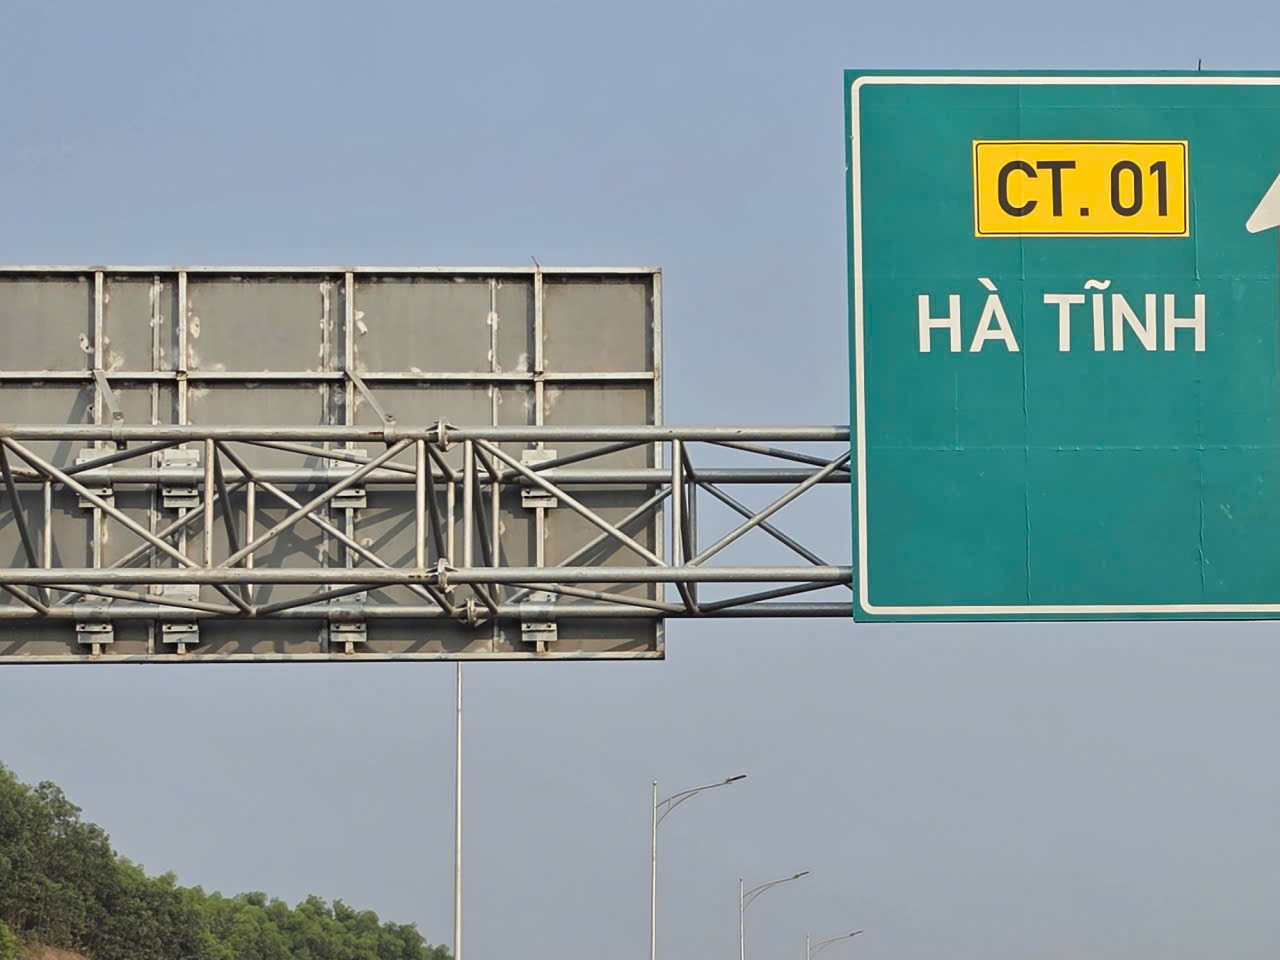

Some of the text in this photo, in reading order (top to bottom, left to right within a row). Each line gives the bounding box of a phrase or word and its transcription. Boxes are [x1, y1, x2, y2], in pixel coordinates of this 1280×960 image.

[997, 160, 1169, 217] CT. 01
[917, 277, 1206, 353] HÀ TĨNH
